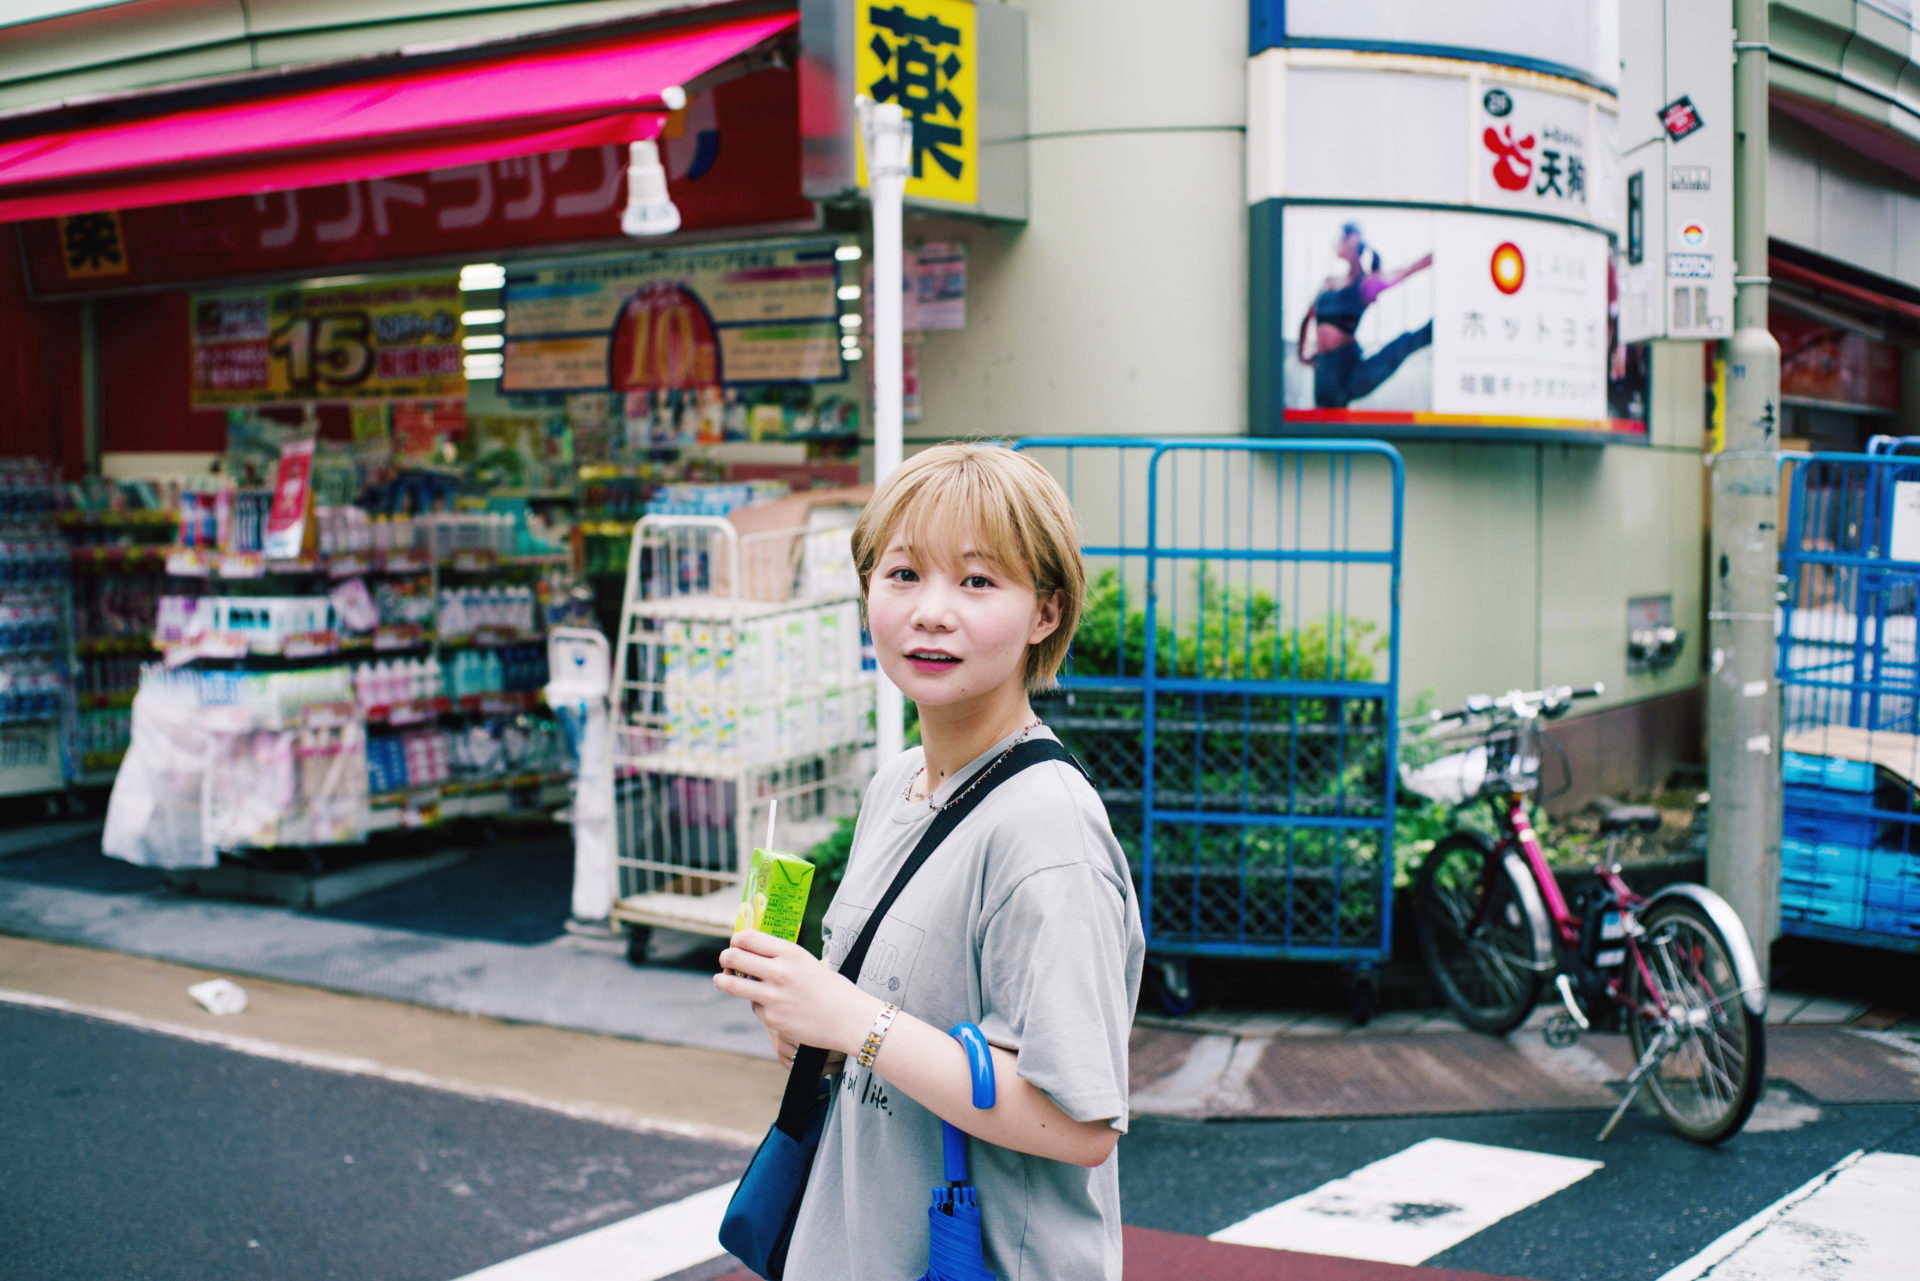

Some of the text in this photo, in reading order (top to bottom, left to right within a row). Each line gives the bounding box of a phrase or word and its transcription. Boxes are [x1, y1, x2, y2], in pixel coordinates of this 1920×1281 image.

[869, 6, 964, 181] 薬
[270, 311, 374, 388] 15
[630, 307, 696, 384] 10
[861, 1071, 893, 1116] life.
